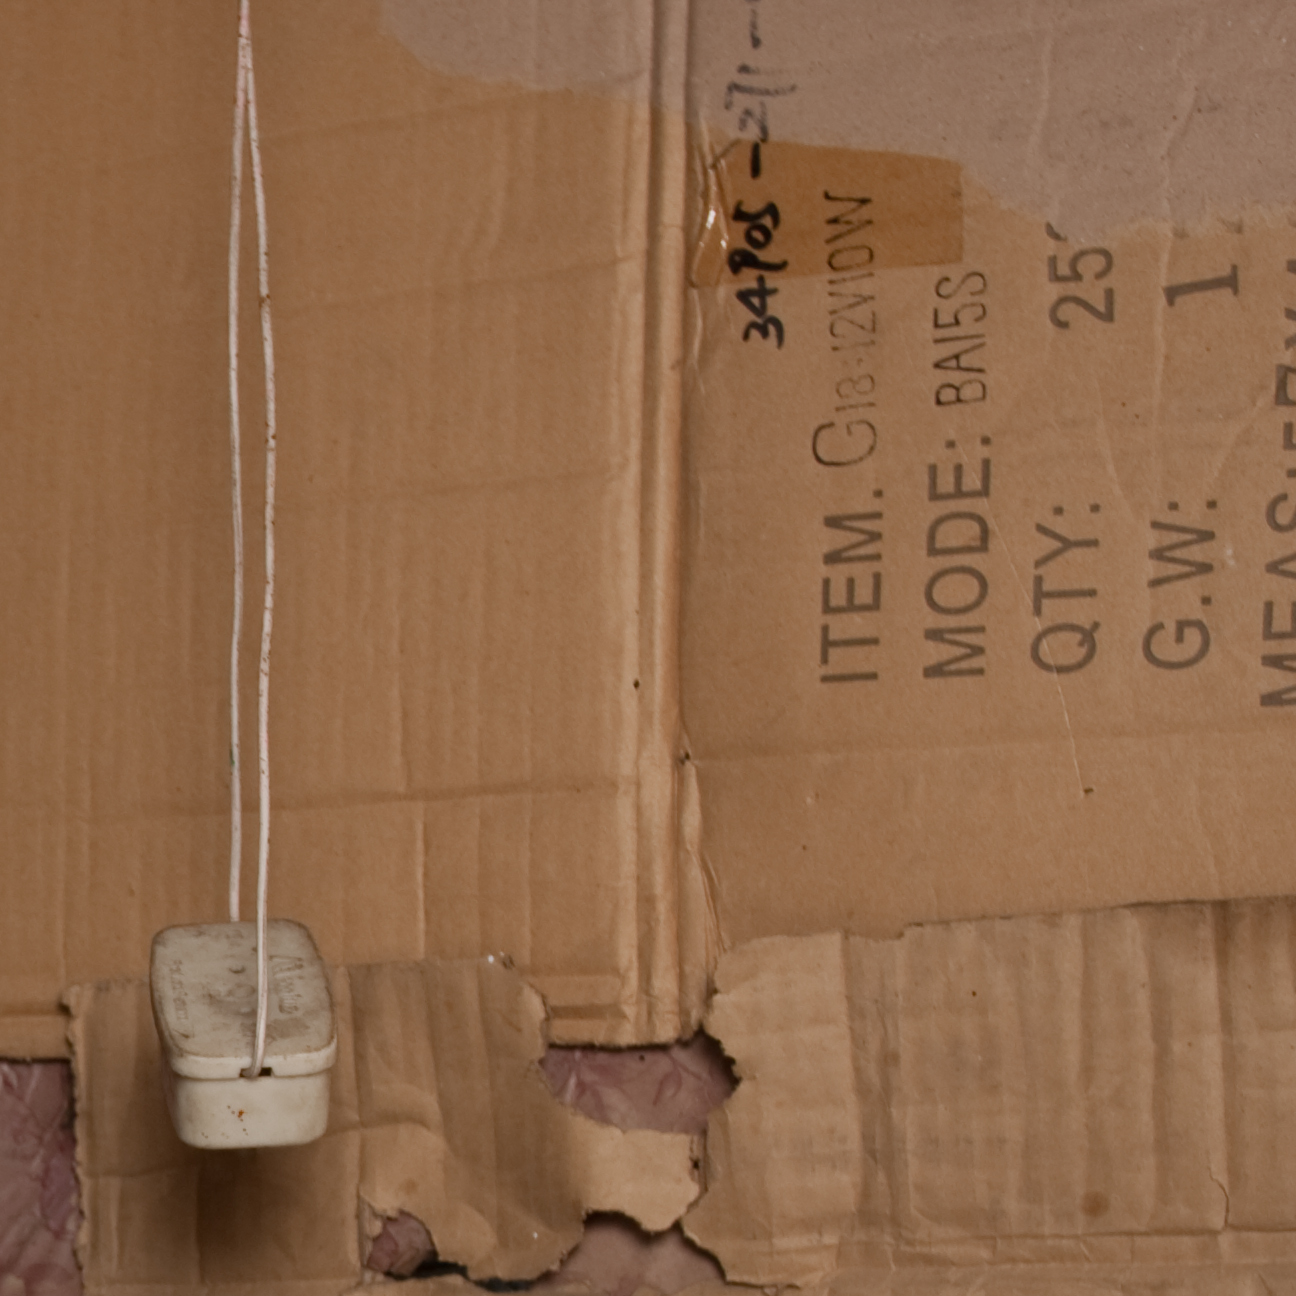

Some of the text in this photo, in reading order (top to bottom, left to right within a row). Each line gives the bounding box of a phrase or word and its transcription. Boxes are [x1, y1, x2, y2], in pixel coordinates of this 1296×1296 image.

[923, 435, 992, 679] MODE:
[1030, 222, 1114, 674] QTY: 25
[820, 489, 883, 683] ITEM.
[1141, 500, 1217, 671] G.W:
